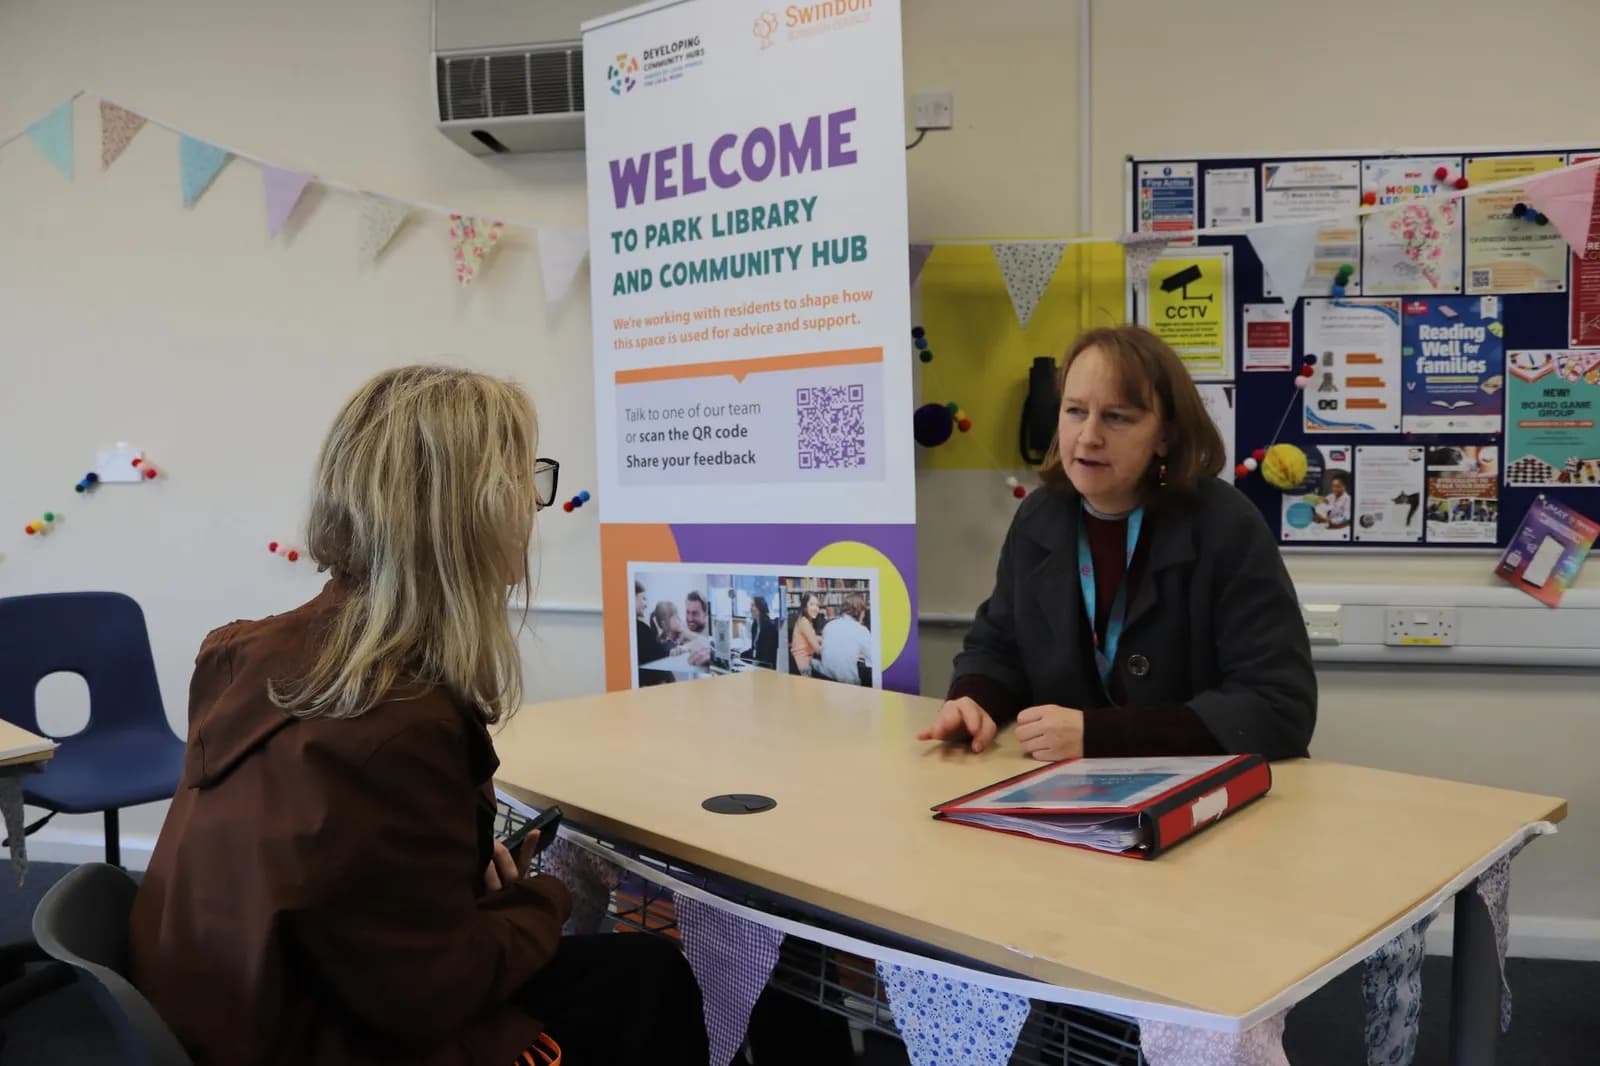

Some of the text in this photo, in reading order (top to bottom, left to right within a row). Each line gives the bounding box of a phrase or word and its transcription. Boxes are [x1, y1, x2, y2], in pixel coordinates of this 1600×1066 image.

[643, 35, 701, 61] DEVELOPING
[608, 107, 858, 209] WELCOME
[1385, 184, 1438, 195] MONDAY
[611, 195, 818, 255] TO PARK LIBRARY
[612, 234, 868, 296] AND COMMUNITY HUB
[613, 288, 874, 331] We're working with residents to shape how
[1165, 306, 1208, 320] CCTV
[613, 311, 862, 351] this space is used for advice and support.
[1419, 322, 1486, 343] Reading
[1421, 340, 1481, 357] Well for
[1416, 356, 1487, 374] families
[625, 402, 761, 423] Talk to one of our team
[1521, 401, 1592, 410] BOARD GAME
[1538, 409, 1575, 417] GROUP
[625, 423, 749, 444] or scan the QR code
[626, 449, 757, 471] Share your feedback
